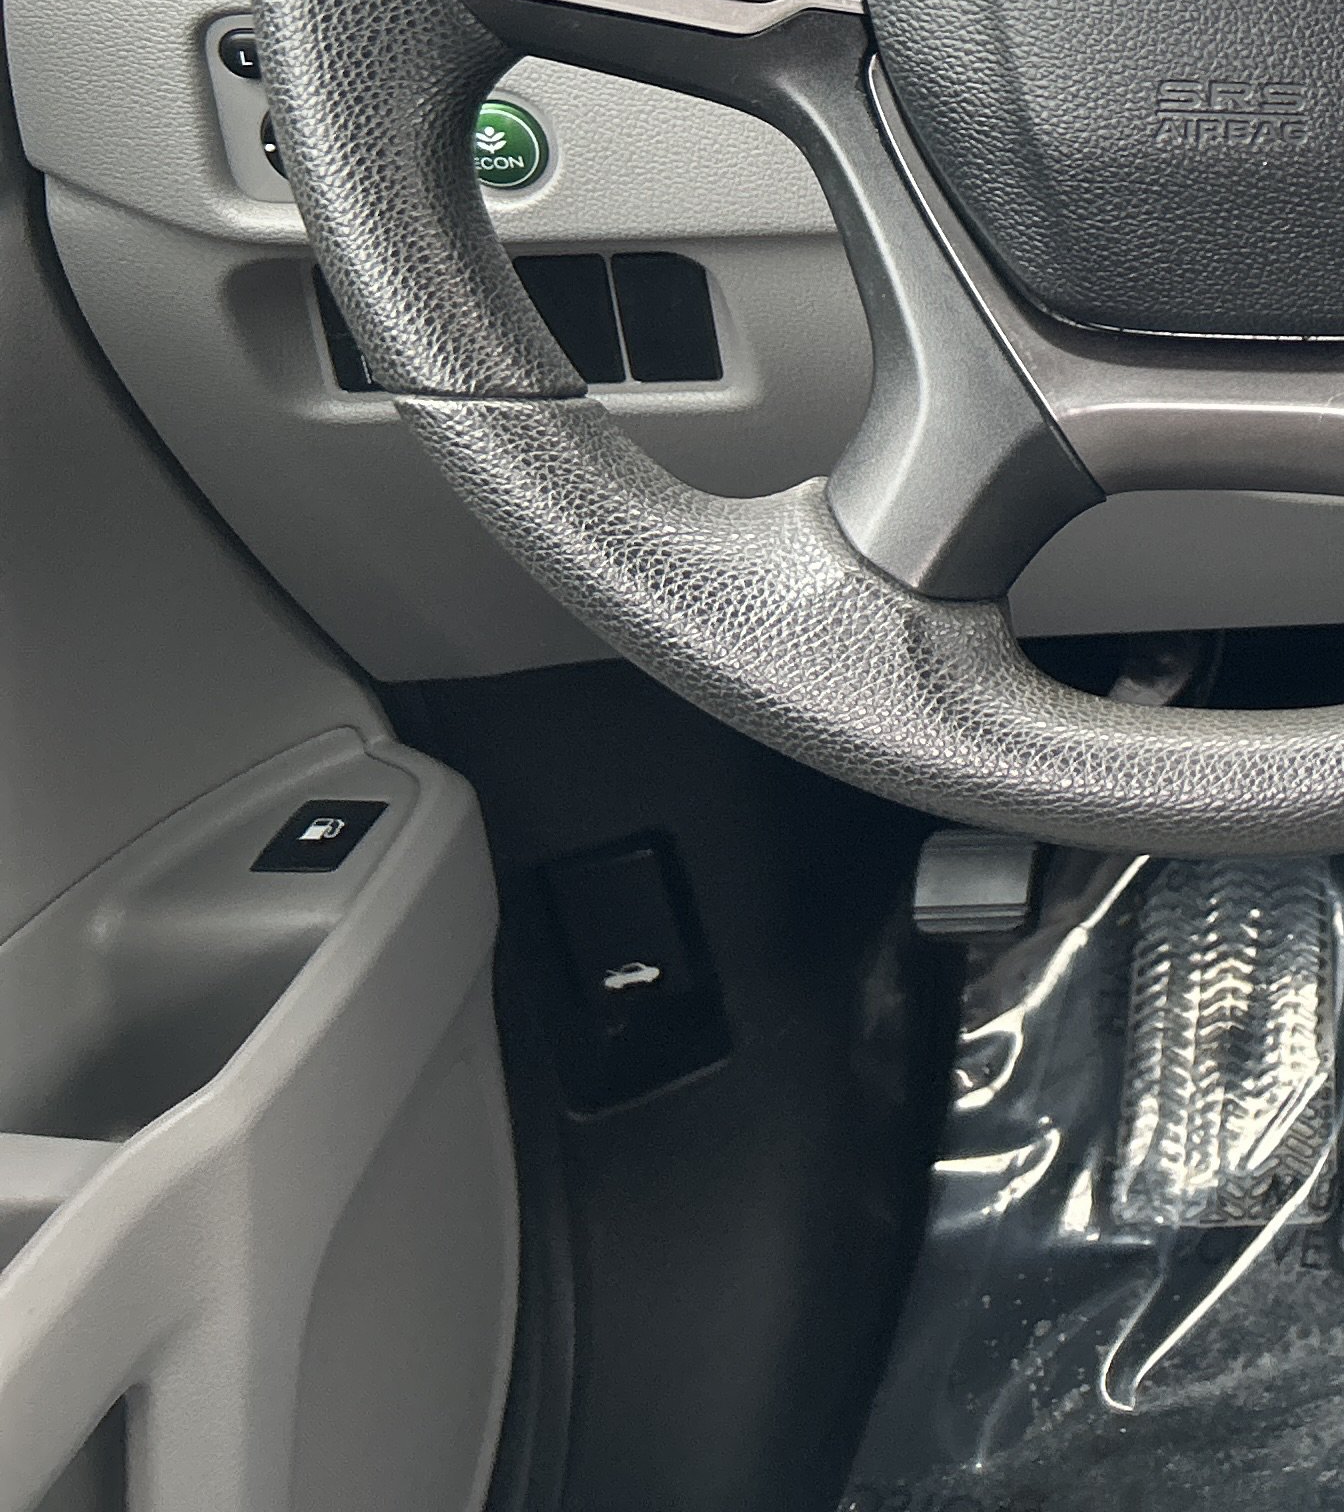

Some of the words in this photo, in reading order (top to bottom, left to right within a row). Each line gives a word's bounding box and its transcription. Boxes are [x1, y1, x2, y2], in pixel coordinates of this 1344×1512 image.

[240, 50, 254, 67] L
[1156, 78, 1304, 112] SRS
[1156, 118, 1305, 144] AIRBAG
